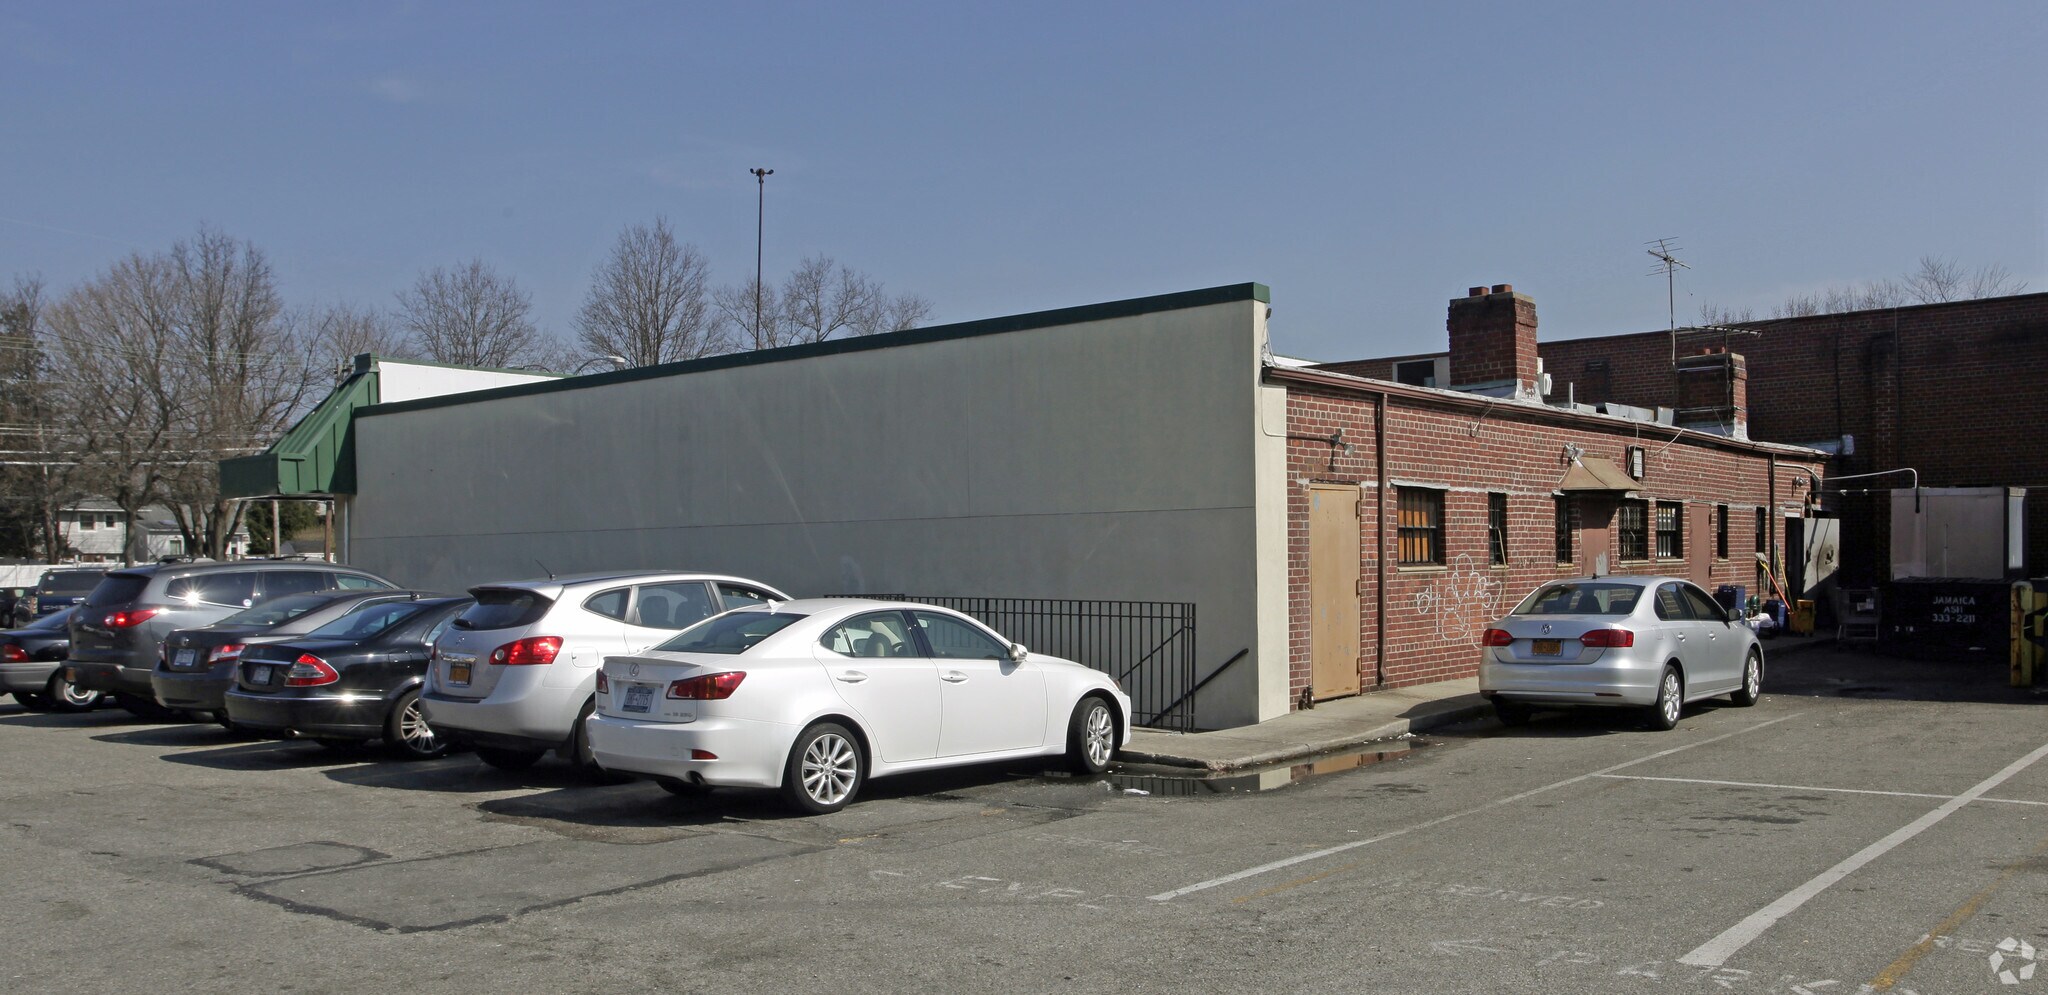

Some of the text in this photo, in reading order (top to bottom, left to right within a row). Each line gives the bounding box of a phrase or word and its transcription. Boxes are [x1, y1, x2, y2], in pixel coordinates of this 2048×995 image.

[1932, 596, 1976, 606] JAMAICA
[1943, 606, 1963, 614] ASH
[1932, 613, 1976, 623] 333-2211
